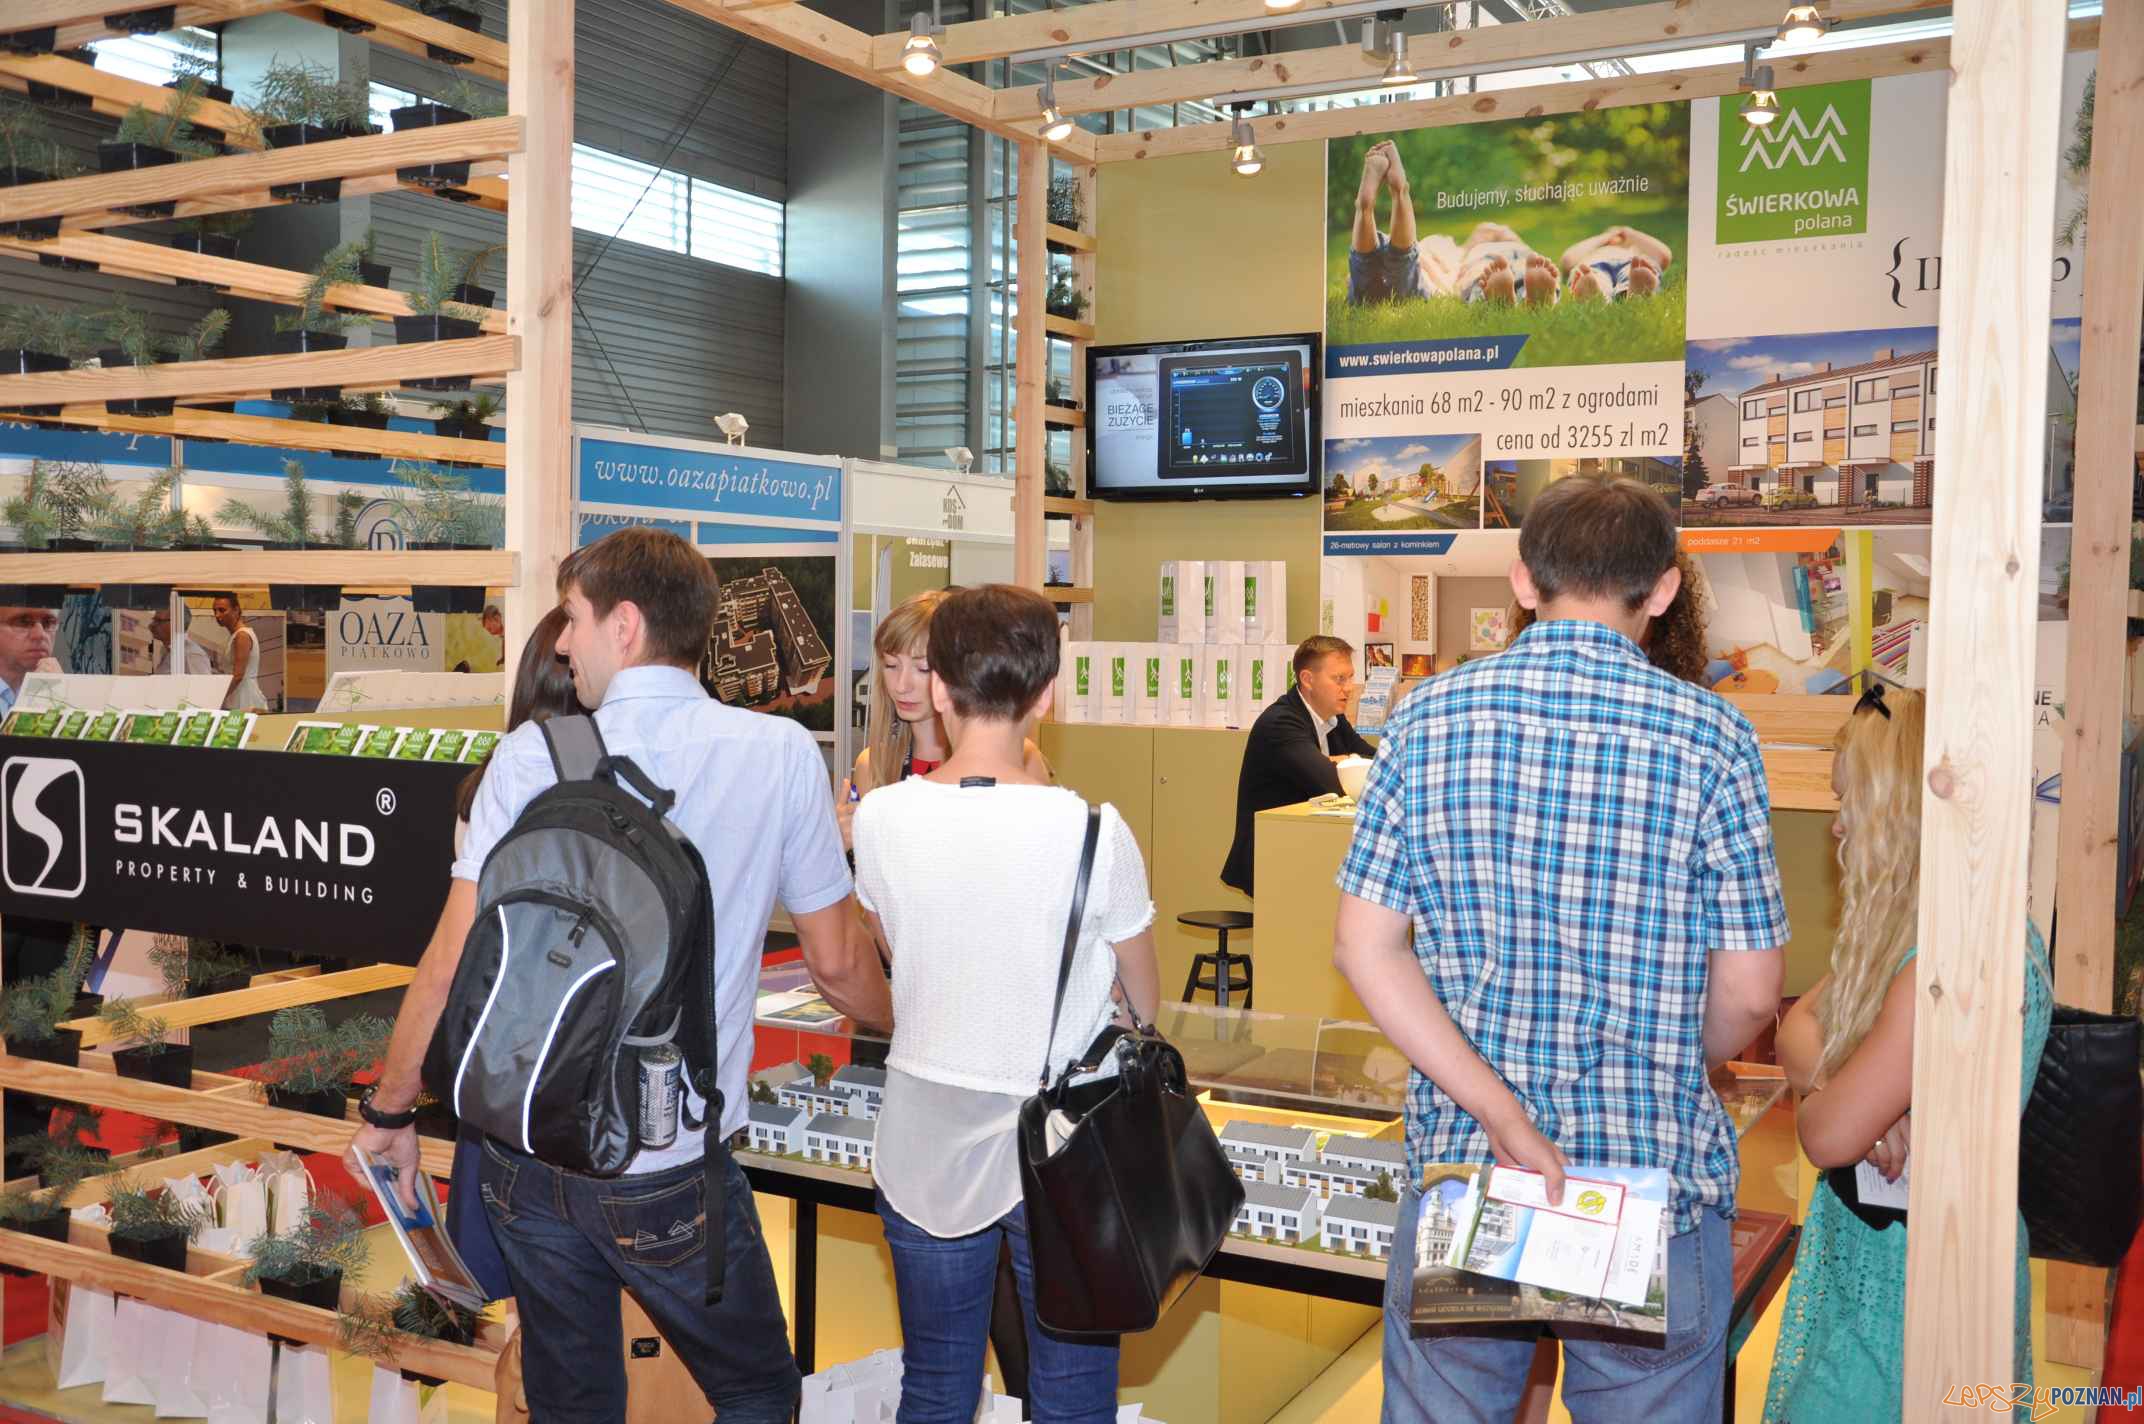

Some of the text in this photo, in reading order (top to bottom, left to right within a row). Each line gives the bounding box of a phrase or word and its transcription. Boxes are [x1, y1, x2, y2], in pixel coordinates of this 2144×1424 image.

[1437, 175, 1649, 210] Budujemy, słuchając uważnie
[1726, 187, 1860, 217] ŚWIERKOWA
[1794, 212, 1853, 235] polana
[1339, 344, 1500, 369] www.swierkowapolana.pl
[1340, 393, 1424, 418] mieszkania
[1431, 391, 1451, 414] 68
[1458, 390, 1484, 413] m2
[1501, 388, 1522, 411] 90
[1529, 387, 1556, 410] m2
[1562, 393, 1571, 408] z
[1577, 382, 1659, 414] ogrodami
[1497, 433, 1534, 450] cena
[1541, 424, 1560, 448] od
[1568, 424, 1613, 448] 3255
[1641, 422, 1669, 446] m2
[594, 457, 833, 512] www.oazapiatkowo.pl
[340, 611, 428, 646] OAZA
[114, 803, 376, 868] SKALAND
[115, 859, 375, 905] PROPERTY & BUILDING
